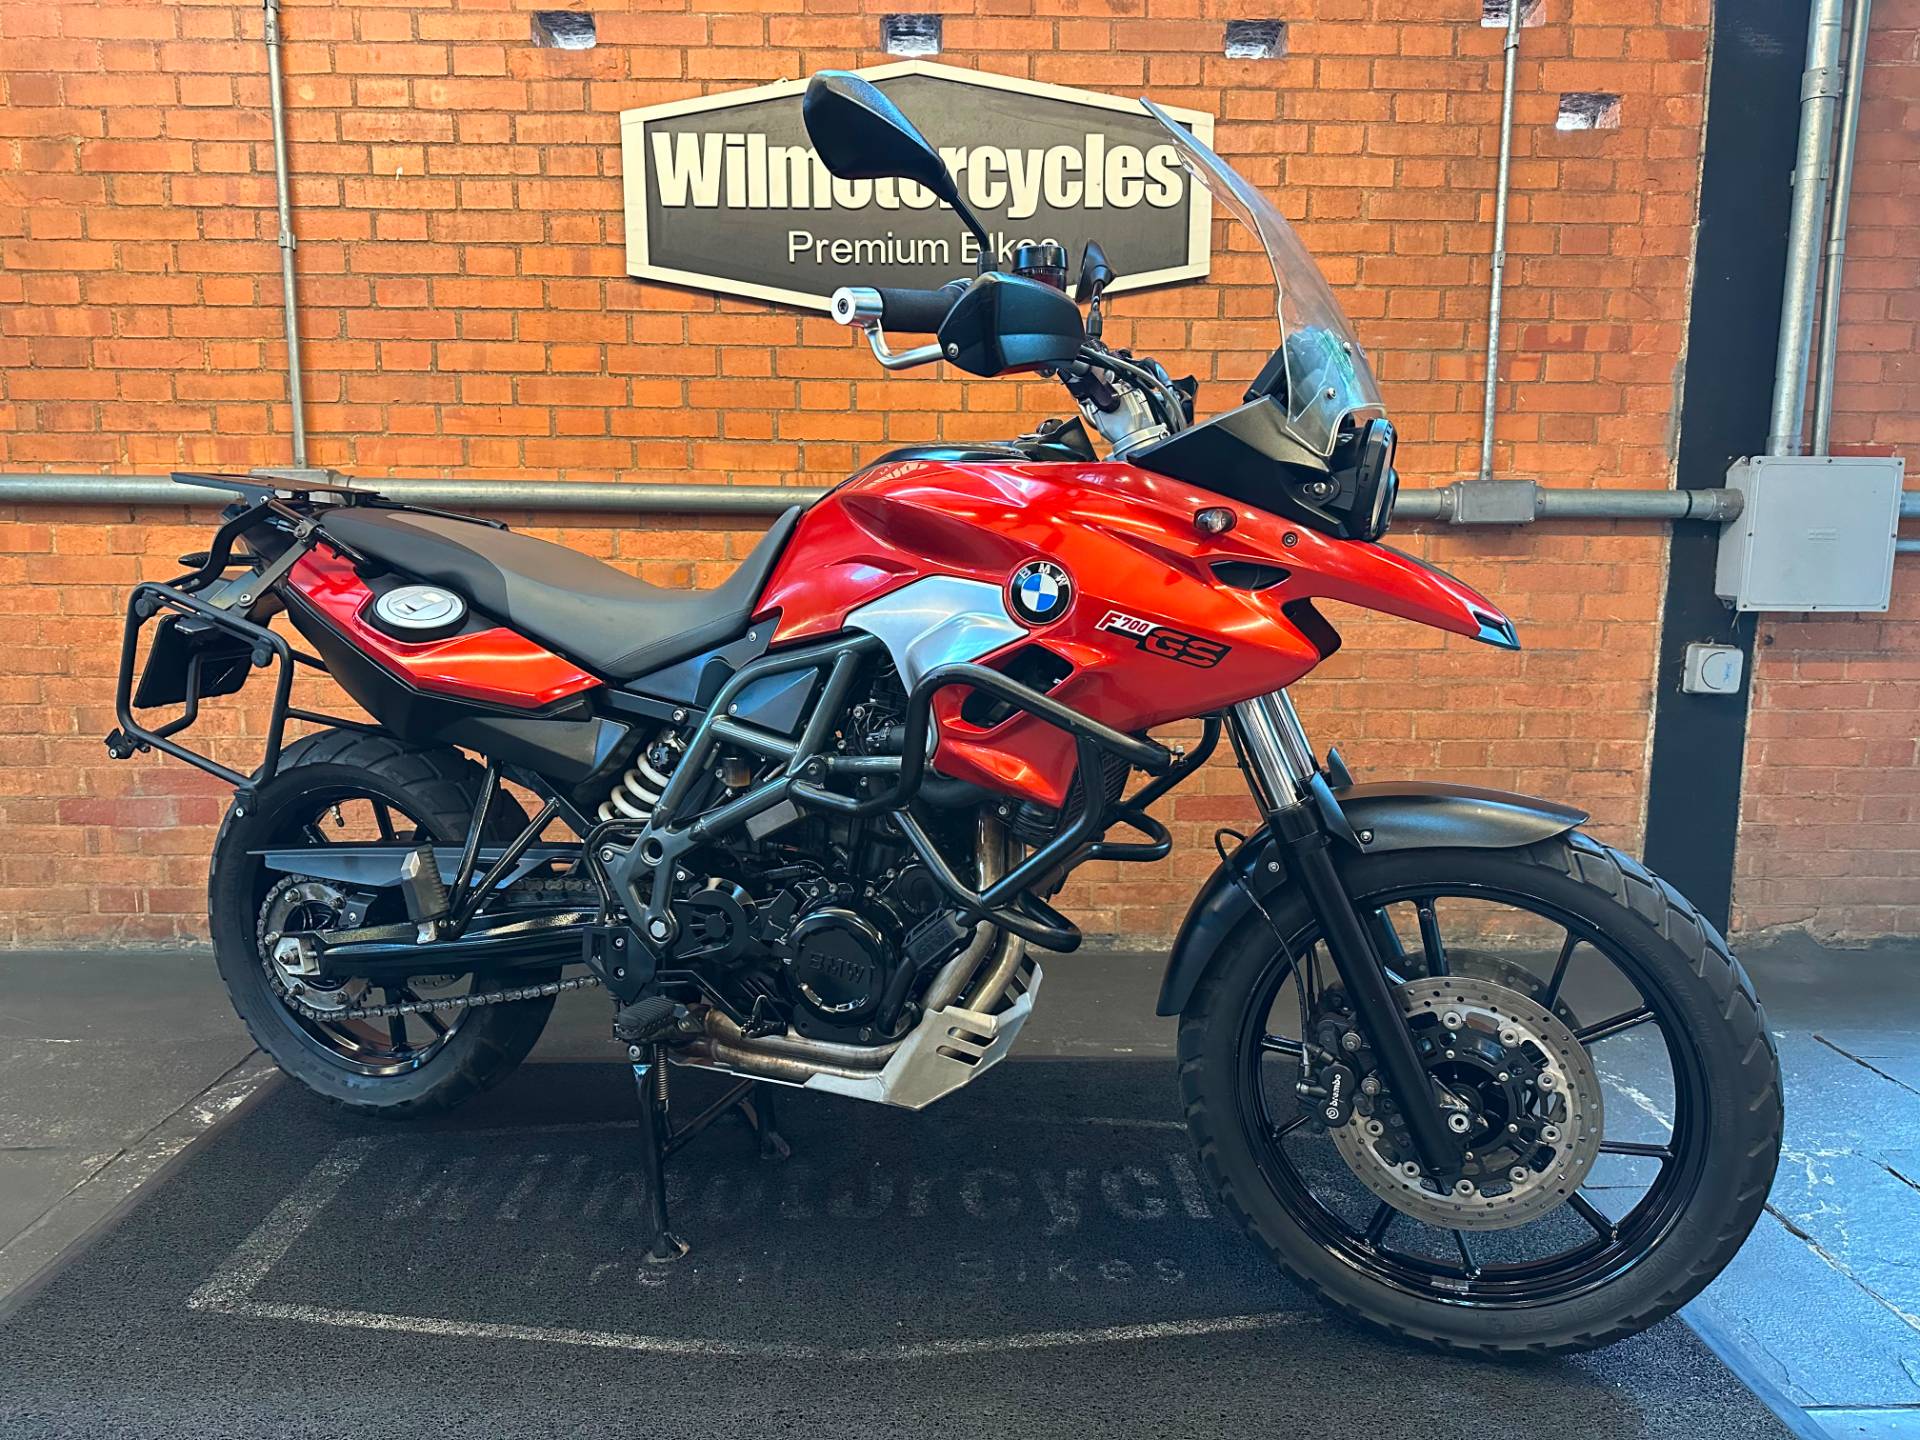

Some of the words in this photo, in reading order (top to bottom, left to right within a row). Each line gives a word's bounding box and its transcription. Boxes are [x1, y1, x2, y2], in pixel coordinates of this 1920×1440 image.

[788, 230, 949, 265] Premium
[1018, 562, 1069, 587] BMW
[1142, 627, 1231, 668] GS
[809, 951, 865, 984] BMW
[1330, 1073, 1342, 1107] brembo
